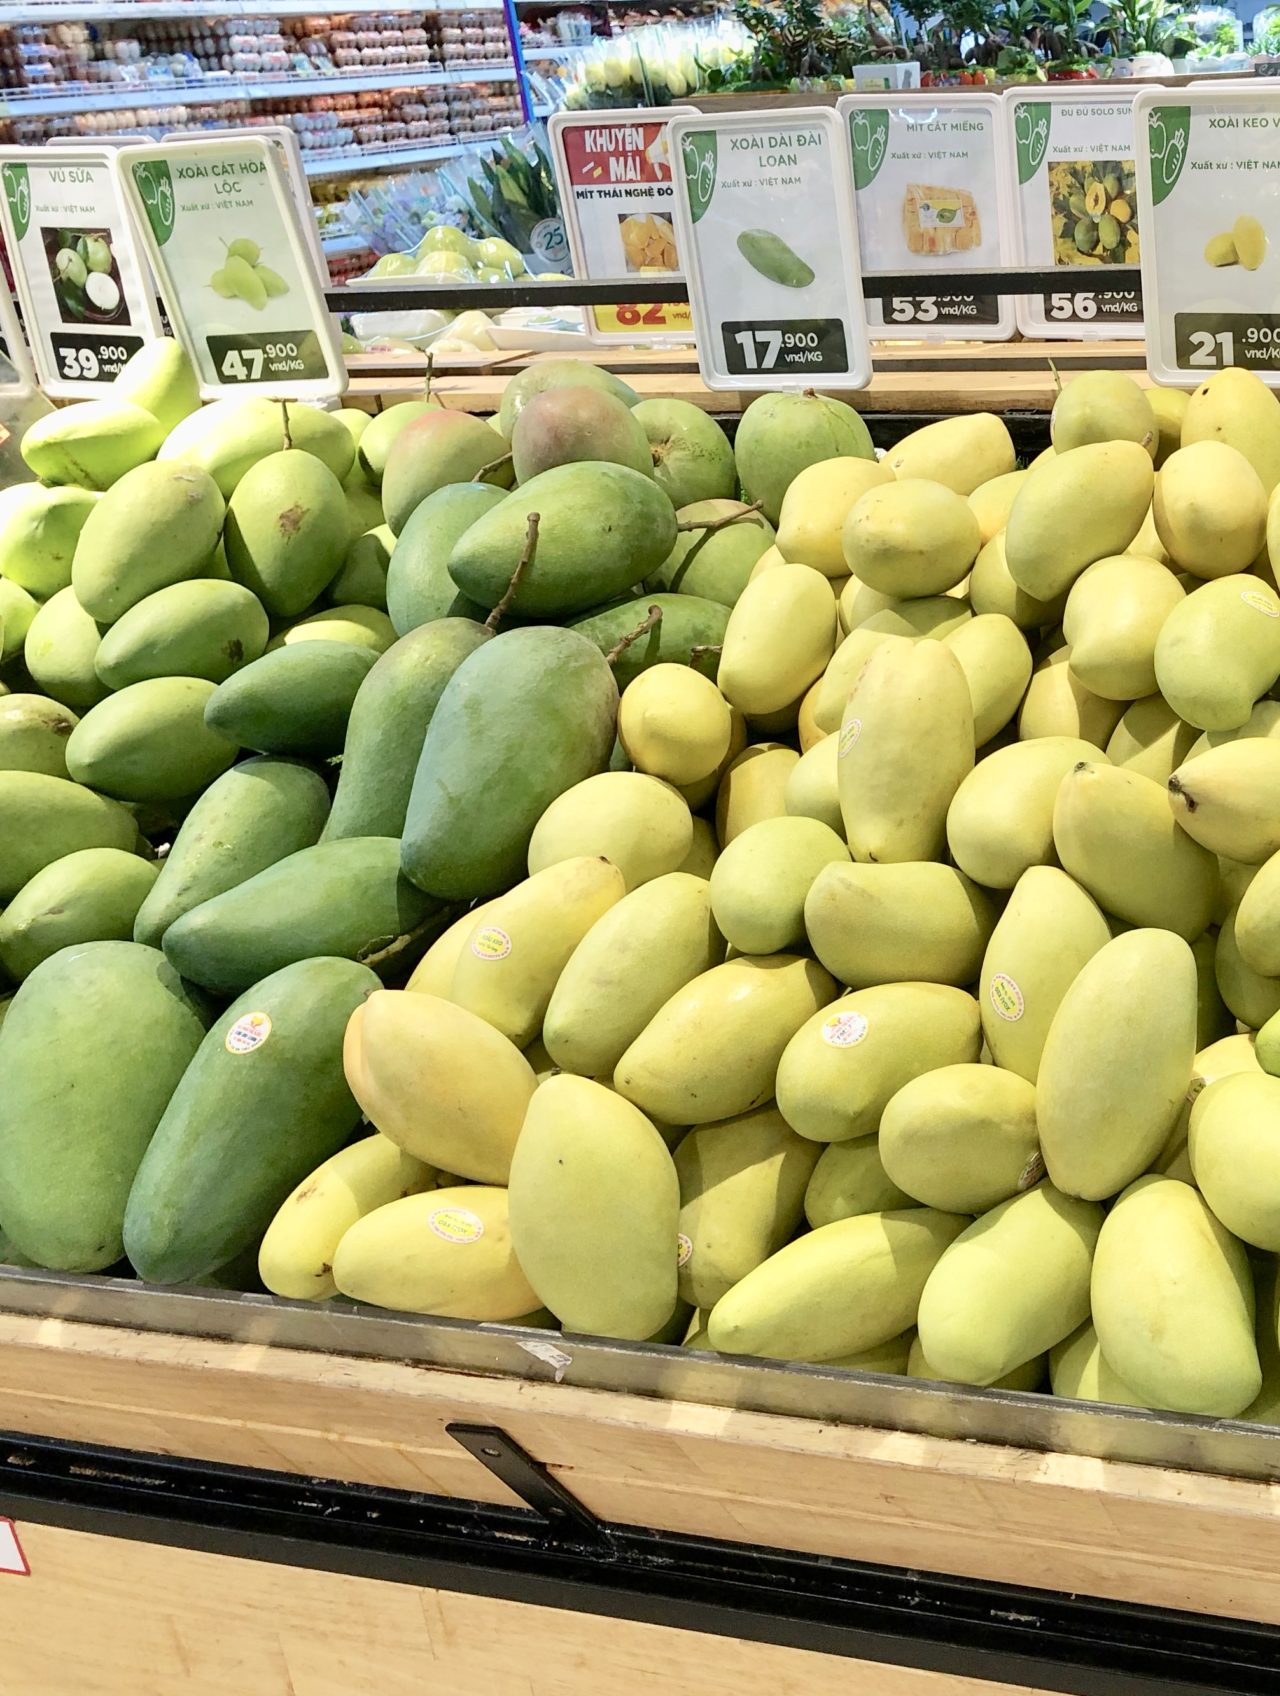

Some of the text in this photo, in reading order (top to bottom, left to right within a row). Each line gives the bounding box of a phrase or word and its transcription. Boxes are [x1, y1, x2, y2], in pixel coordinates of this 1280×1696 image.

[1091, 107, 1114, 116] SOLO
[951, 120, 984, 132] MIẾNG
[1209, 116, 1239, 129] XOÀI
[1243, 117, 1269, 128] KEO
[584, 124, 645, 153] KHUYẾN
[730, 131, 822, 151] XOÀI DÀI ĐÀI
[949, 151, 969, 159] NAM
[1111, 144, 1131, 152] NAM
[609, 152, 641, 182] MÃI
[759, 153, 798, 168] LOAN
[1191, 160, 1213, 170] Xuất
[1236, 159, 1260, 170] VIỆT
[176, 162, 208, 179] XOÀI
[211, 161, 235, 177] CÁT
[781, 176, 801, 185] NAM
[214, 180, 242, 196] LỘC
[576, 188, 594, 200] MÍT
[596, 187, 623, 199] THÁI
[624, 186, 655, 200] NGHỆ
[80, 206, 96, 214] NAM
[235, 200, 254, 209] NAM
[543, 226, 564, 250] 25
[891, 296, 939, 322] 53
[940, 304, 977, 316] vnd/KG
[1050, 292, 1098, 320] 56
[1101, 302, 1138, 313] vnd/KG
[616, 302, 667, 326] 82
[734, 330, 818, 369] 17 .900
[1188, 331, 1235, 366] 21
[58, 345, 128, 379] 39 .900
[221, 343, 298, 380] 47 .900
[784, 351, 823, 364] vnd/KG
[269, 359, 304, 373] vnd/KG
